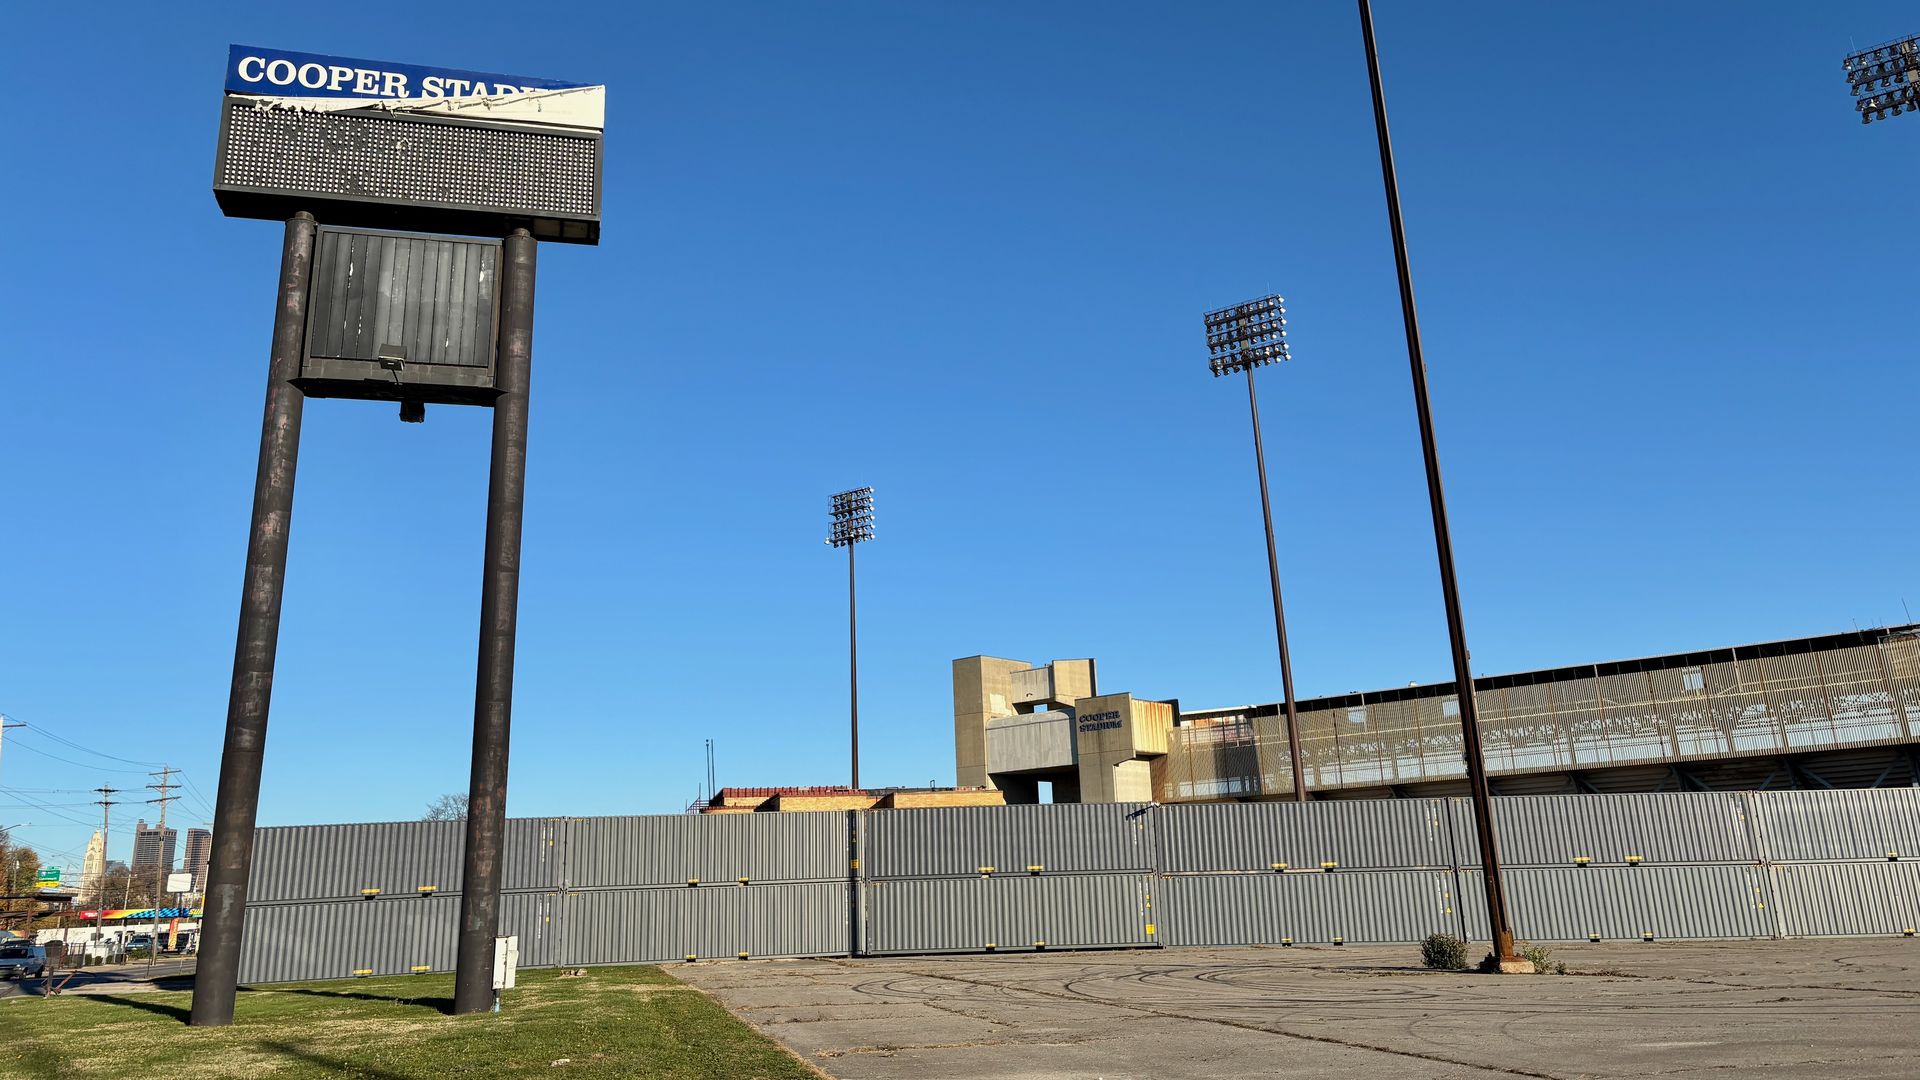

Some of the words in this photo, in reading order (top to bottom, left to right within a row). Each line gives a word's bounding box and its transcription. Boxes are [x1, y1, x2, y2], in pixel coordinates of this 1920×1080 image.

[238, 56, 409, 98] COOPER
[421, 76, 557, 99] STAD
[1079, 710, 1120, 723] COOPER
[1079, 719, 1122, 732] STADIUM
